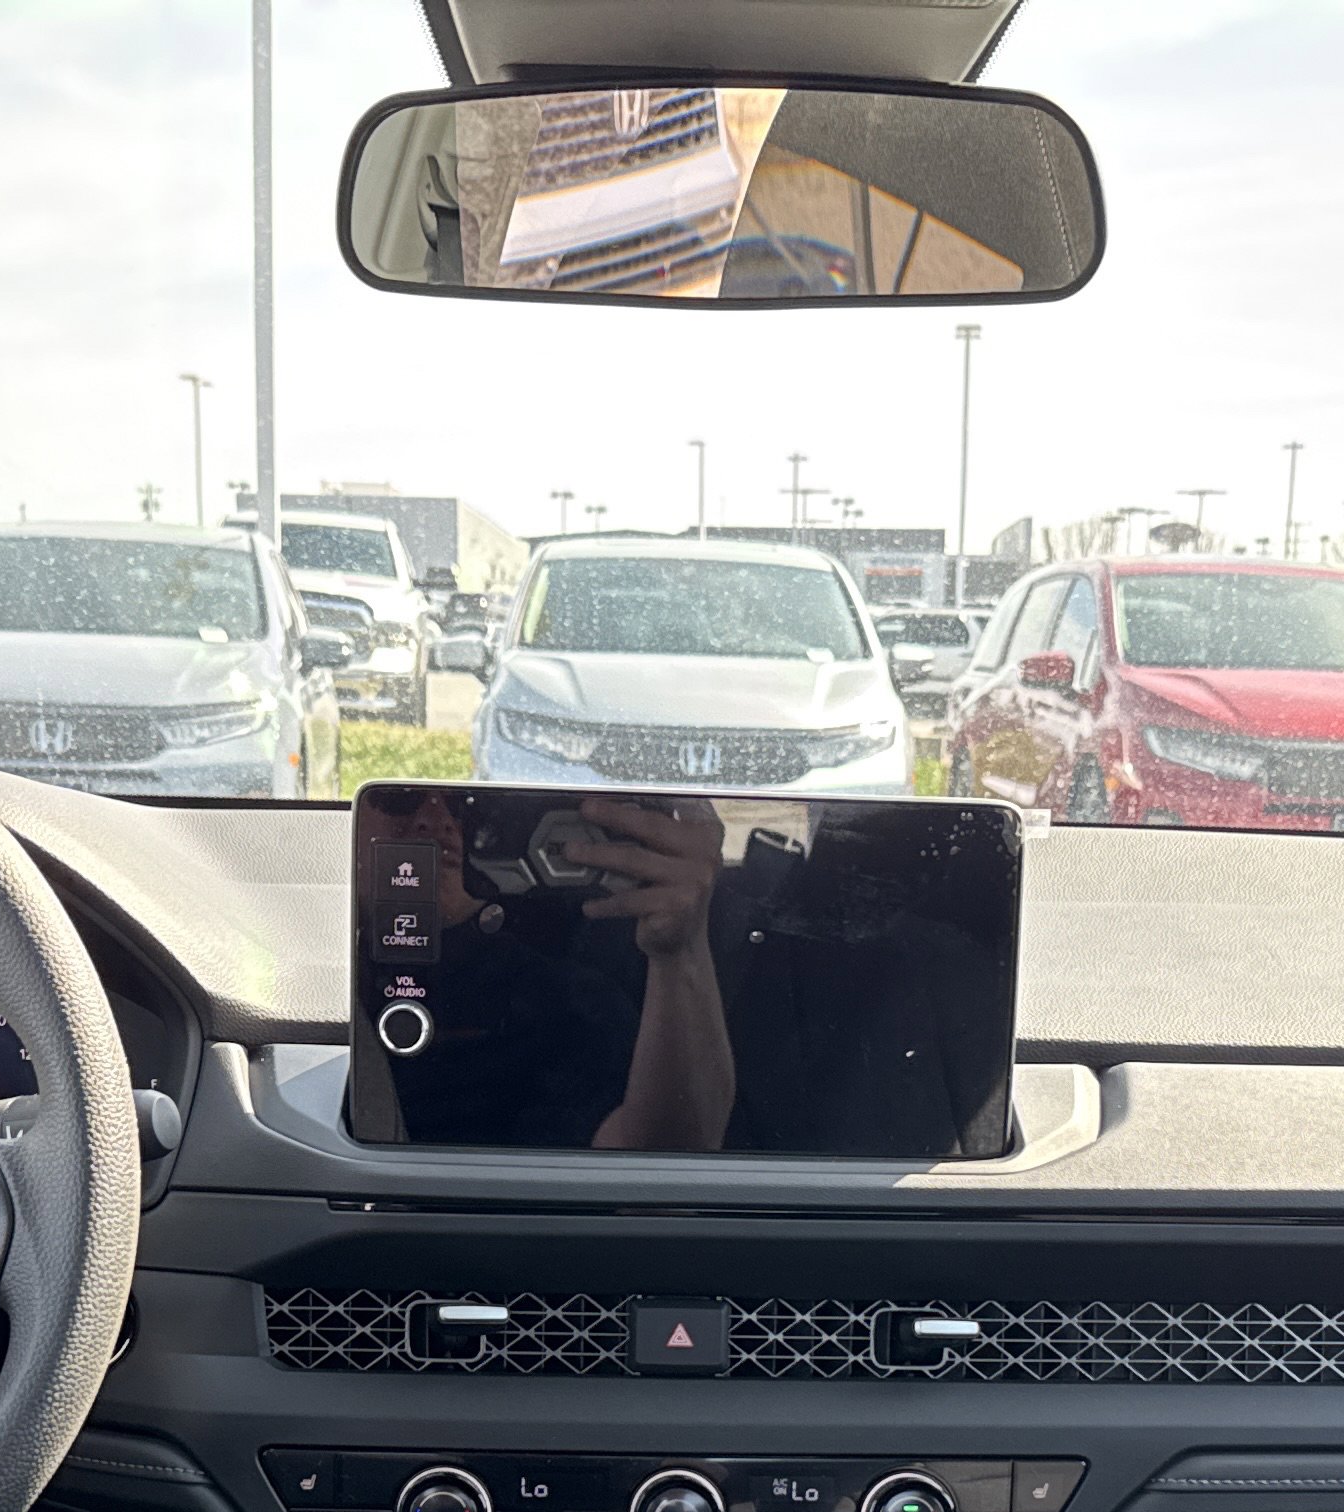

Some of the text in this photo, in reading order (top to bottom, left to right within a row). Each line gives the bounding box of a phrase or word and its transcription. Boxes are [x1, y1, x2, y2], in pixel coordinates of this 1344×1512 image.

[391, 877, 420, 887] HOME
[382, 936, 429, 946] CONNECT
[396, 976, 416, 986] VOL
[396, 987, 426, 998] AUDIO
[521, 1477, 549, 1498] Lo
[792, 1480, 819, 1501] Lo
